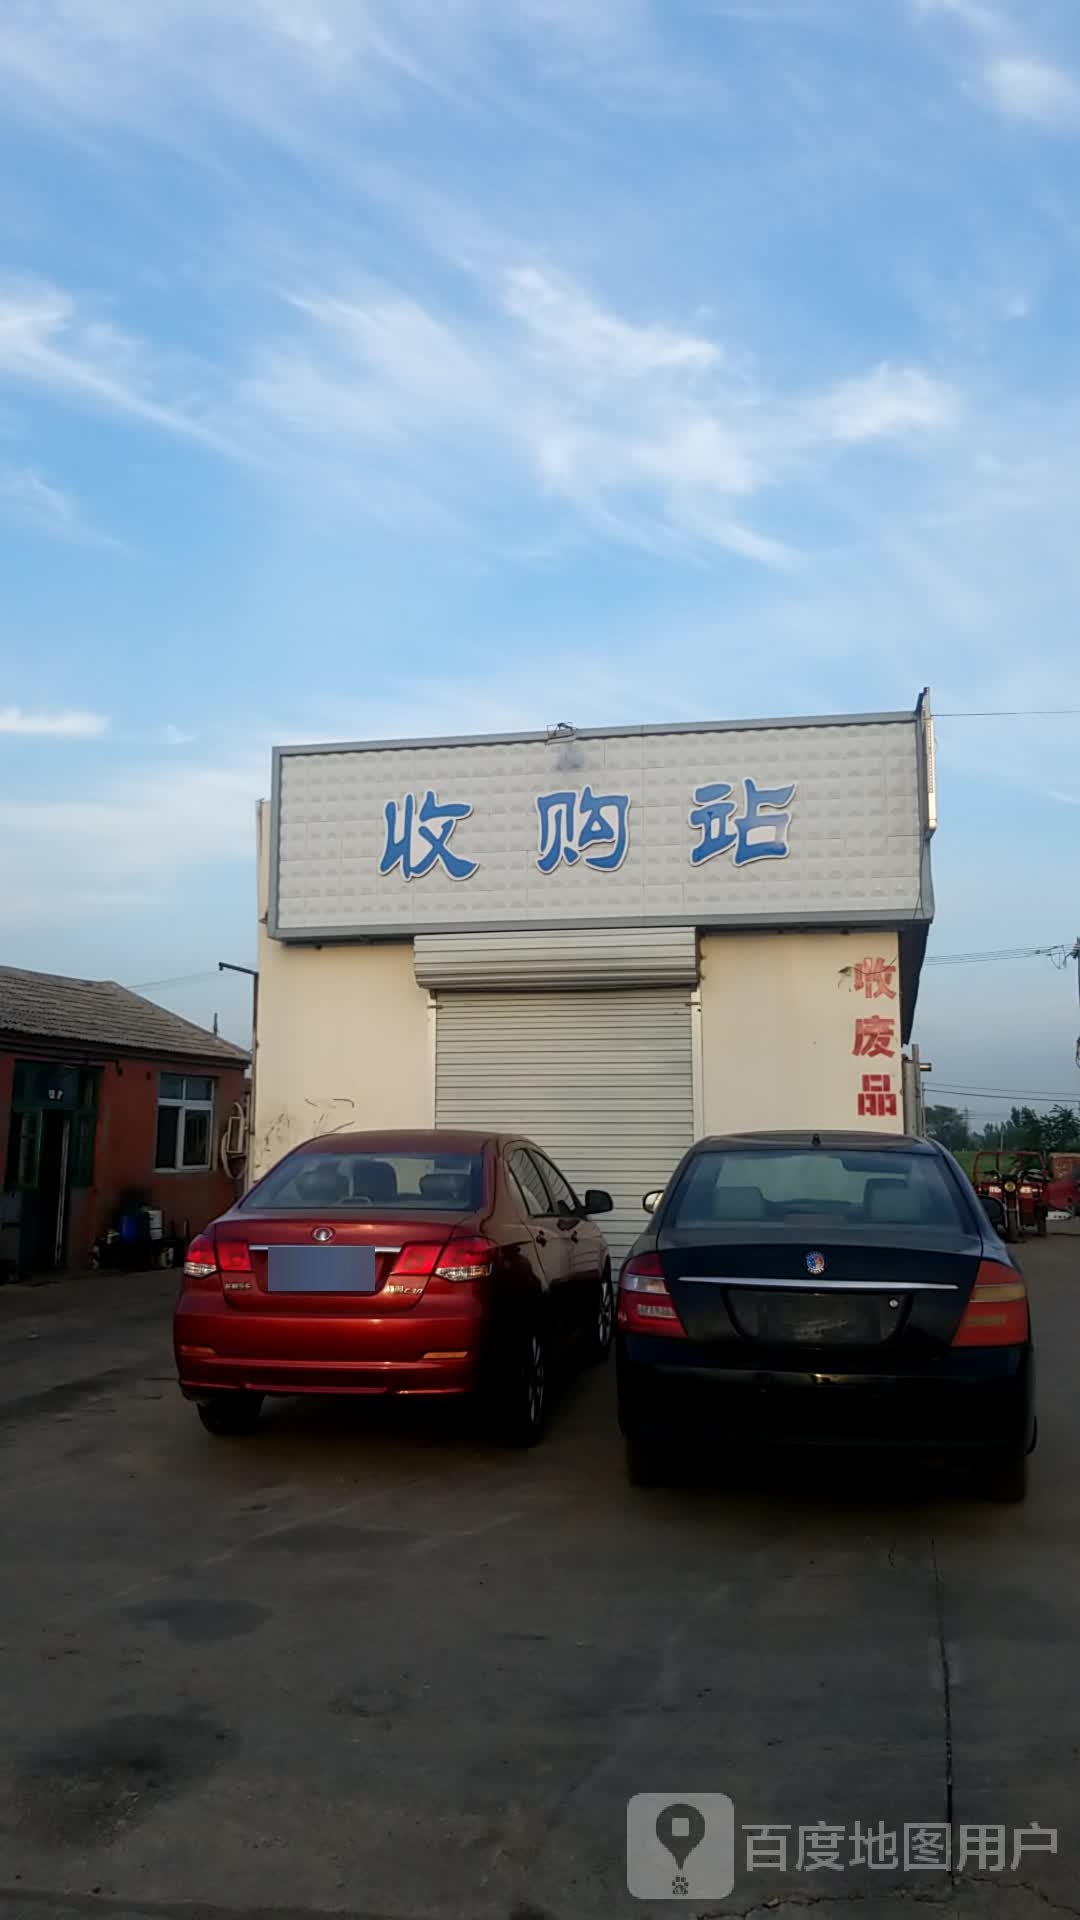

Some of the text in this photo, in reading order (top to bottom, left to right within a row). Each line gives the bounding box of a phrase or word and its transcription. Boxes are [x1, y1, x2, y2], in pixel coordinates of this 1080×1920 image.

[378, 777, 796, 882] 收购站
[852, 957, 897, 1116] 收废品
